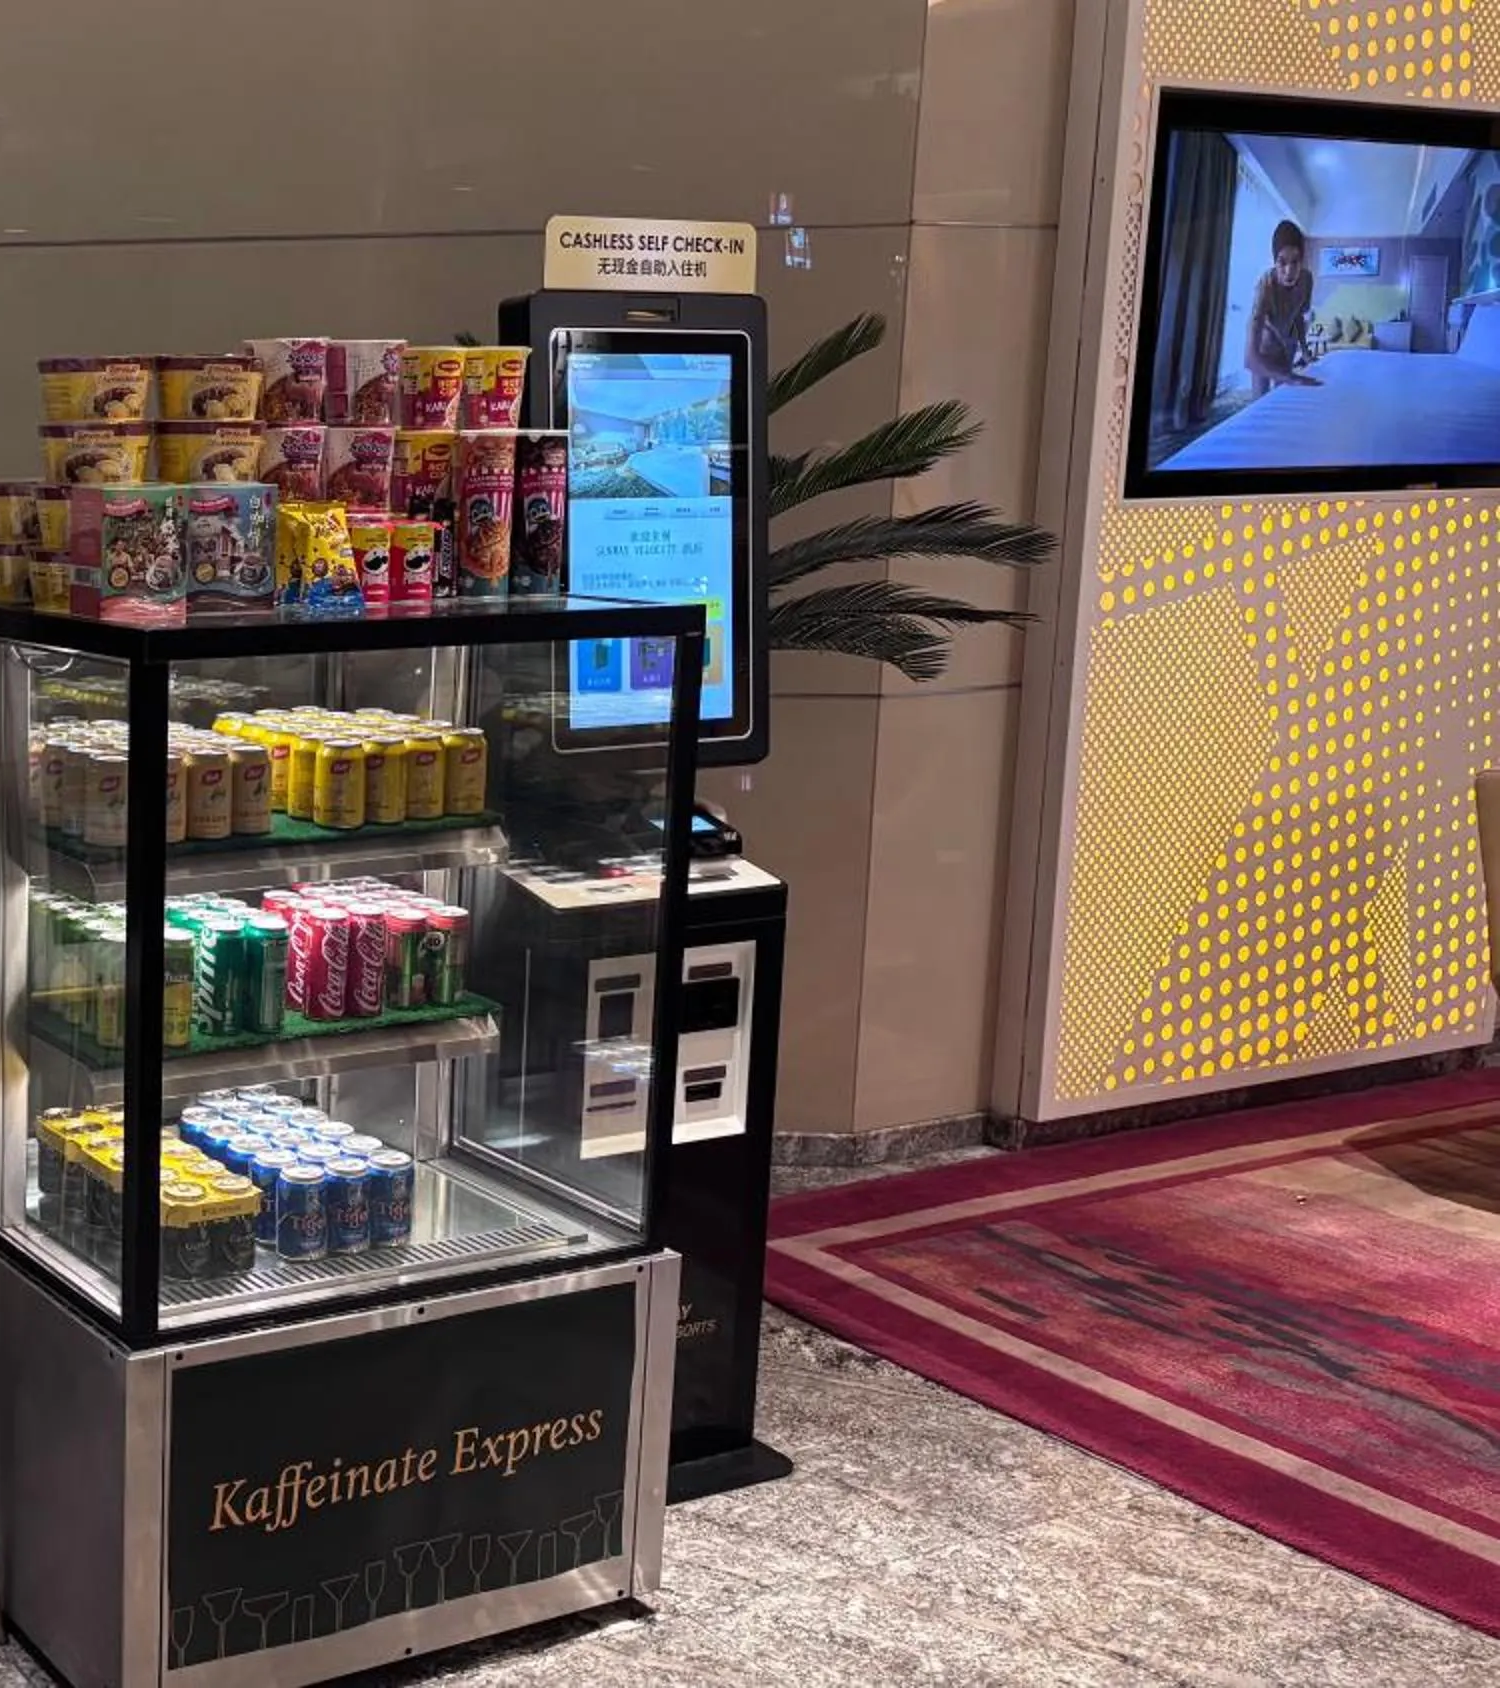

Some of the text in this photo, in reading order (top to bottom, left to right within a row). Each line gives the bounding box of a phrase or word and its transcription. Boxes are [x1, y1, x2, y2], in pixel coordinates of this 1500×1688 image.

[560, 231, 745, 255] CASHLESS SELF CHECK-IN
[597, 257, 708, 278] 无现金自助入住机
[208, 1407, 605, 1534] Kaffeinate Express
